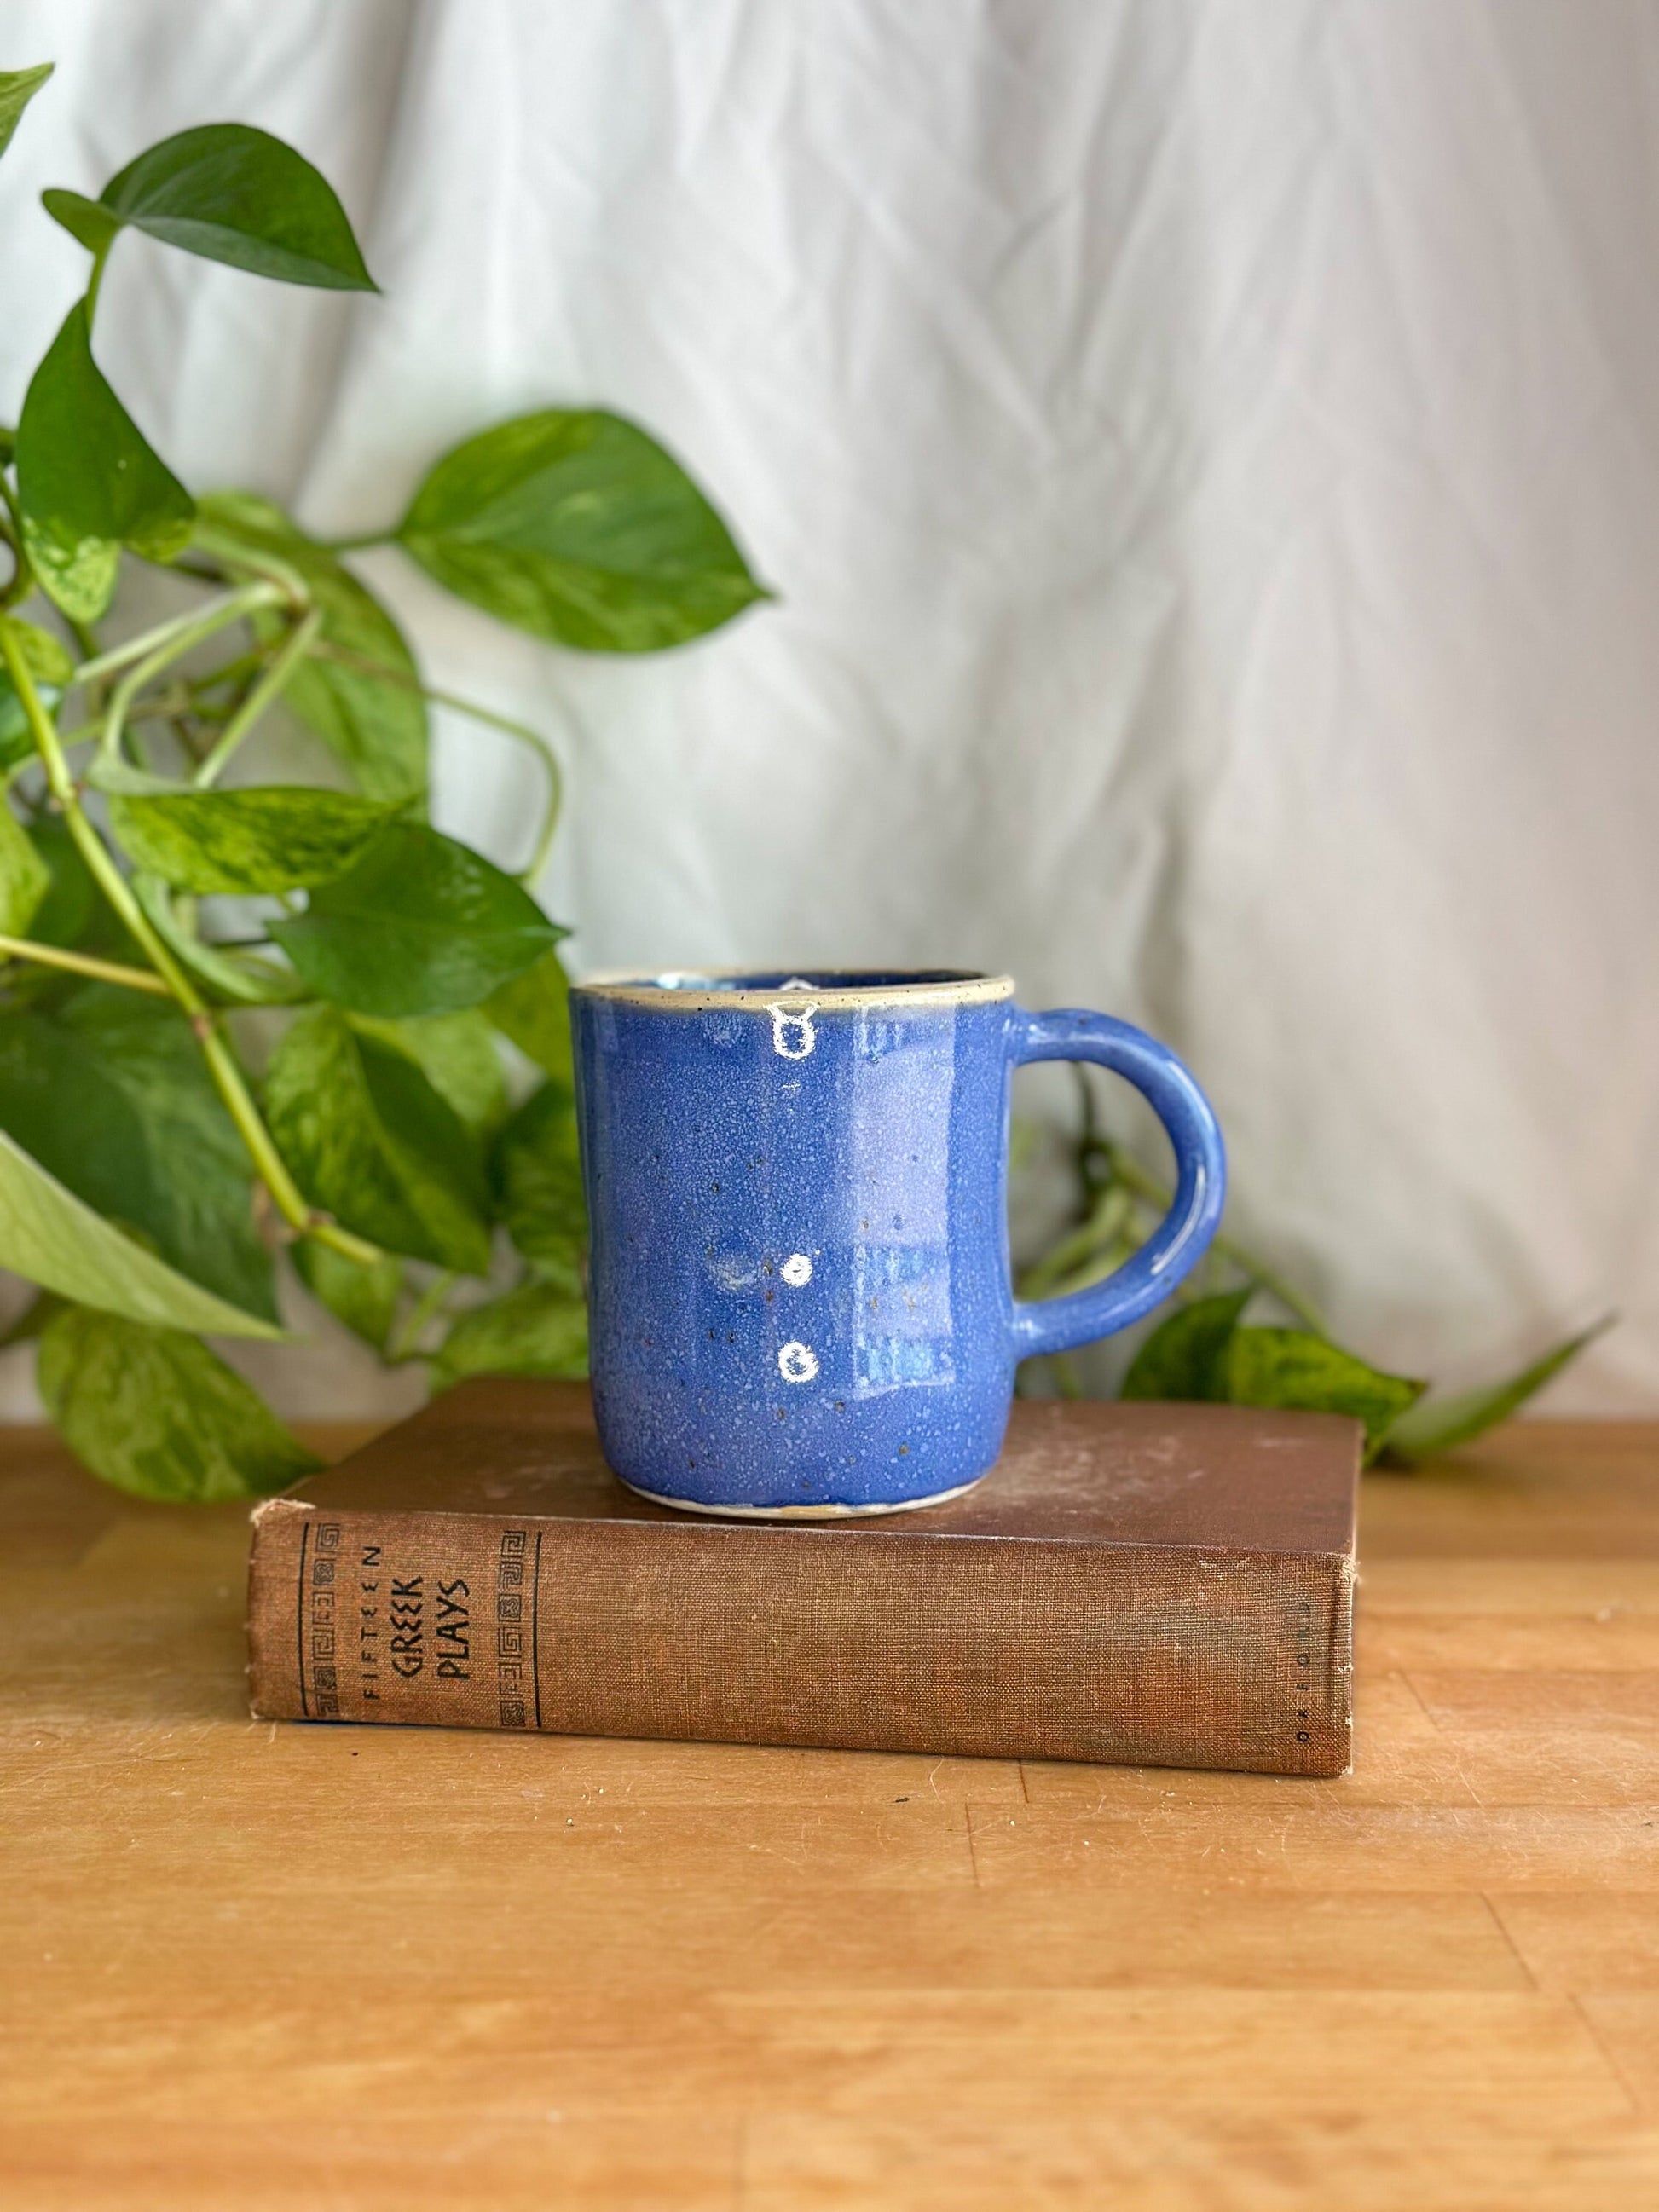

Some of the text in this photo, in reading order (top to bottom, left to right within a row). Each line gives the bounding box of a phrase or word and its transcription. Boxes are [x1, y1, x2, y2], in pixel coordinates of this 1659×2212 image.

[361, 1545, 382, 1700] FIFTEEN
[390, 1576, 423, 1678] GREEK
[436, 1579, 470, 1681] PLAYS
